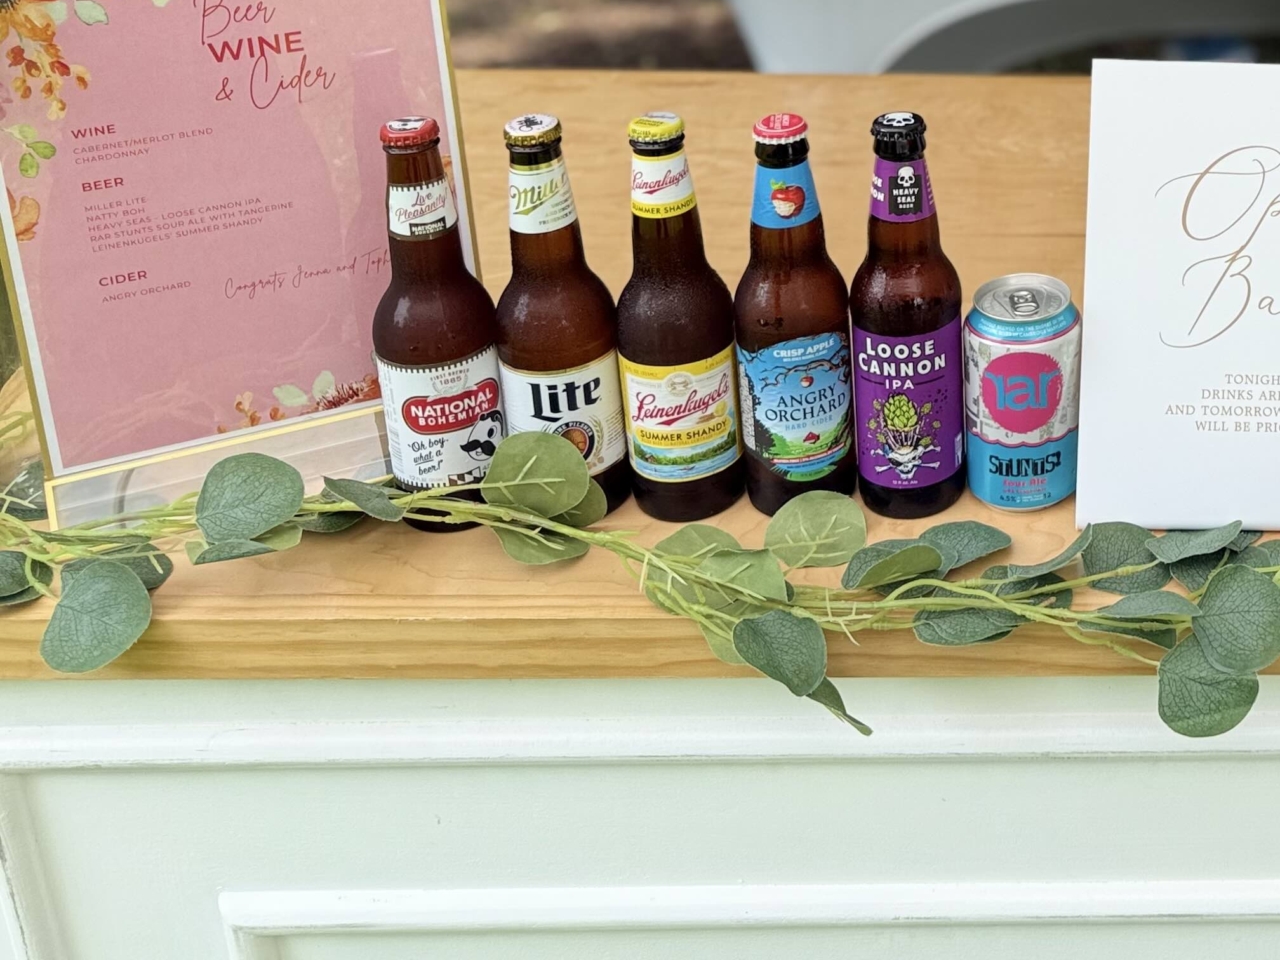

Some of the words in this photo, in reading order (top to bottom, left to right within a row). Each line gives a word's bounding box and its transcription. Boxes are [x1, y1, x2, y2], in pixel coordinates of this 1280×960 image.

[208, 31, 304, 62] WINE
[216, 77, 233, 101] &
[250, 54, 336, 109] Cider
[71, 124, 116, 139] WINE
[73, 133, 175, 155] CABERNET/MERLOT
[179, 128, 213, 138] BLEND
[75, 147, 150, 165] CHARDONNAY
[82, 177, 124, 192] BEER
[893, 188, 919, 196] HEAVY
[84, 200, 122, 212] MILLER
[126, 197, 147, 206] LITE
[411, 192, 433, 207] Live
[632, 202, 660, 214] SUMMER
[664, 199, 693, 213] SHANDY
[86, 211, 119, 222] NATTY
[122, 207, 145, 217] BOH
[88, 221, 123, 232] HEAVY
[126, 215, 151, 226] SEAS
[162, 209, 195, 220] LOOSE
[198, 201, 242, 214] CANNON
[245, 198, 261, 206] IPA
[90, 232, 111, 243] RAR
[114, 225, 153, 239] STUNTS
[156, 221, 184, 231] SOUR
[188, 217, 206, 225] ALE
[209, 212, 235, 222] WITH
[239, 202, 294, 217] TANGERINE
[176, 224, 220, 238] SUMMER
[223, 217, 263, 230] SHANDY
[412, 221, 444, 232] NATIONAL
[99, 271, 147, 287] CIDER
[225, 271, 287, 299] Congrats
[292, 265, 331, 288] Jenna
[336, 257, 357, 274] and
[102, 292, 137, 303] ANGRY
[140, 281, 190, 295] ORCHARD
[773, 348, 804, 358] CRISP
[806, 338, 835, 355] APPLE
[866, 337, 935, 359] LOOSE
[858, 353, 946, 377] CANNON
[439, 376, 462, 386] 1885
[886, 379, 914, 389] IPA
[985, 369, 1060, 412] rar
[410, 388, 493, 417] NATIONAL
[526, 377, 601, 423] Lite
[632, 372, 729, 422] Leinenkugel's
[777, 382, 836, 408] ANGRY
[1201, 389, 1254, 401] DRINKS
[765, 392, 846, 422] ORCHARD
[1165, 404, 1196, 415] AND
[640, 430, 682, 441] SUMMER
[687, 419, 727, 440] SHANDY
[785, 423, 807, 431] HARD
[812, 415, 833, 426] CIDER
[1195, 420, 1229, 432] WILL
[1234, 422, 1251, 432] BE
[989, 451, 1061, 477] STUNTS!
